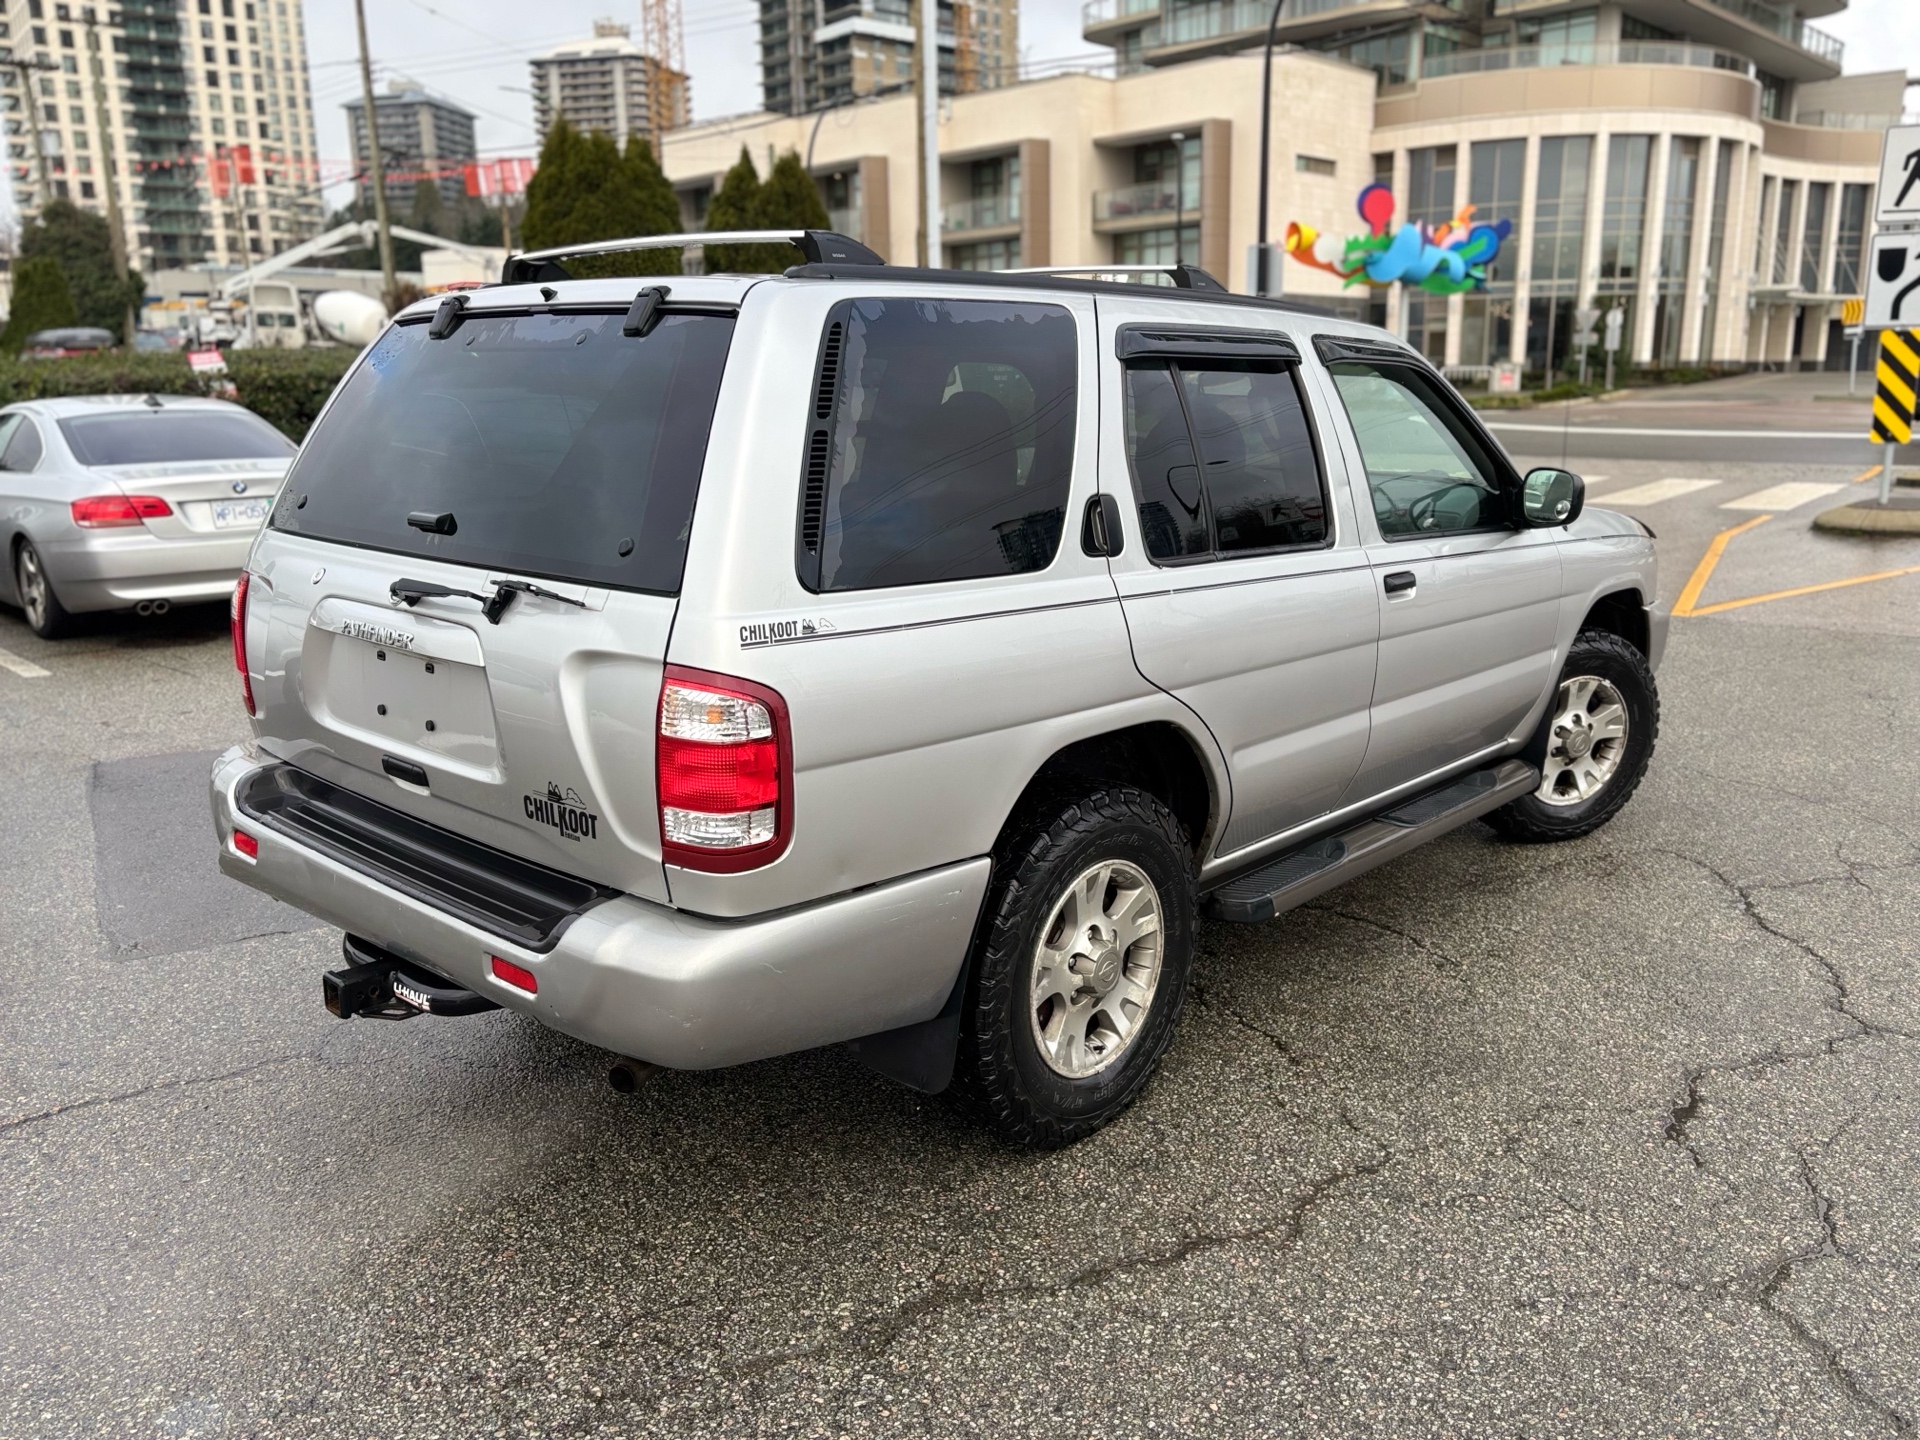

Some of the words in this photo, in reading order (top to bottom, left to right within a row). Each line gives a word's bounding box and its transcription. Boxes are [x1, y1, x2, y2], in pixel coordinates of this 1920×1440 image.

[341, 618, 415, 650] PATHFINDER
[739, 620, 798, 644] CHILKOOT
[523, 794, 598, 840] CHILKOOT
[393, 981, 432, 1006] U-HAUL
